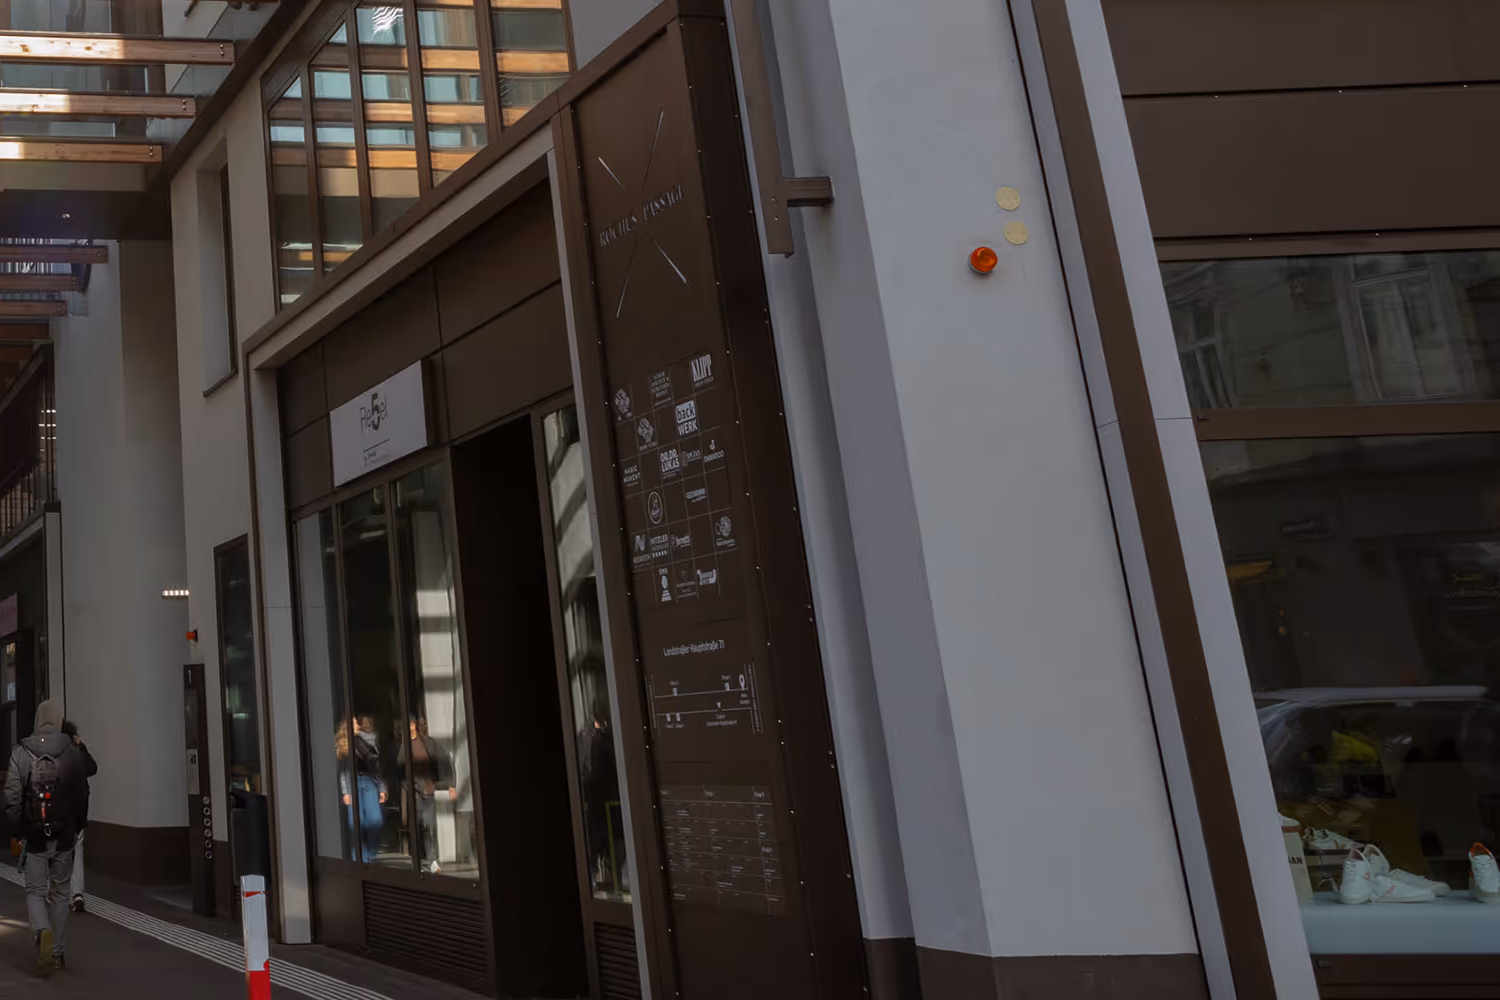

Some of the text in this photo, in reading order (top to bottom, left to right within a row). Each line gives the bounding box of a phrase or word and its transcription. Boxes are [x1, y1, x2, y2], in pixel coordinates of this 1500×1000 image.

[690, 354, 712, 382] KLIPP
[677, 403, 695, 423] back
[677, 419, 698, 437] WERK
[661, 459, 680, 473] LUKAS
